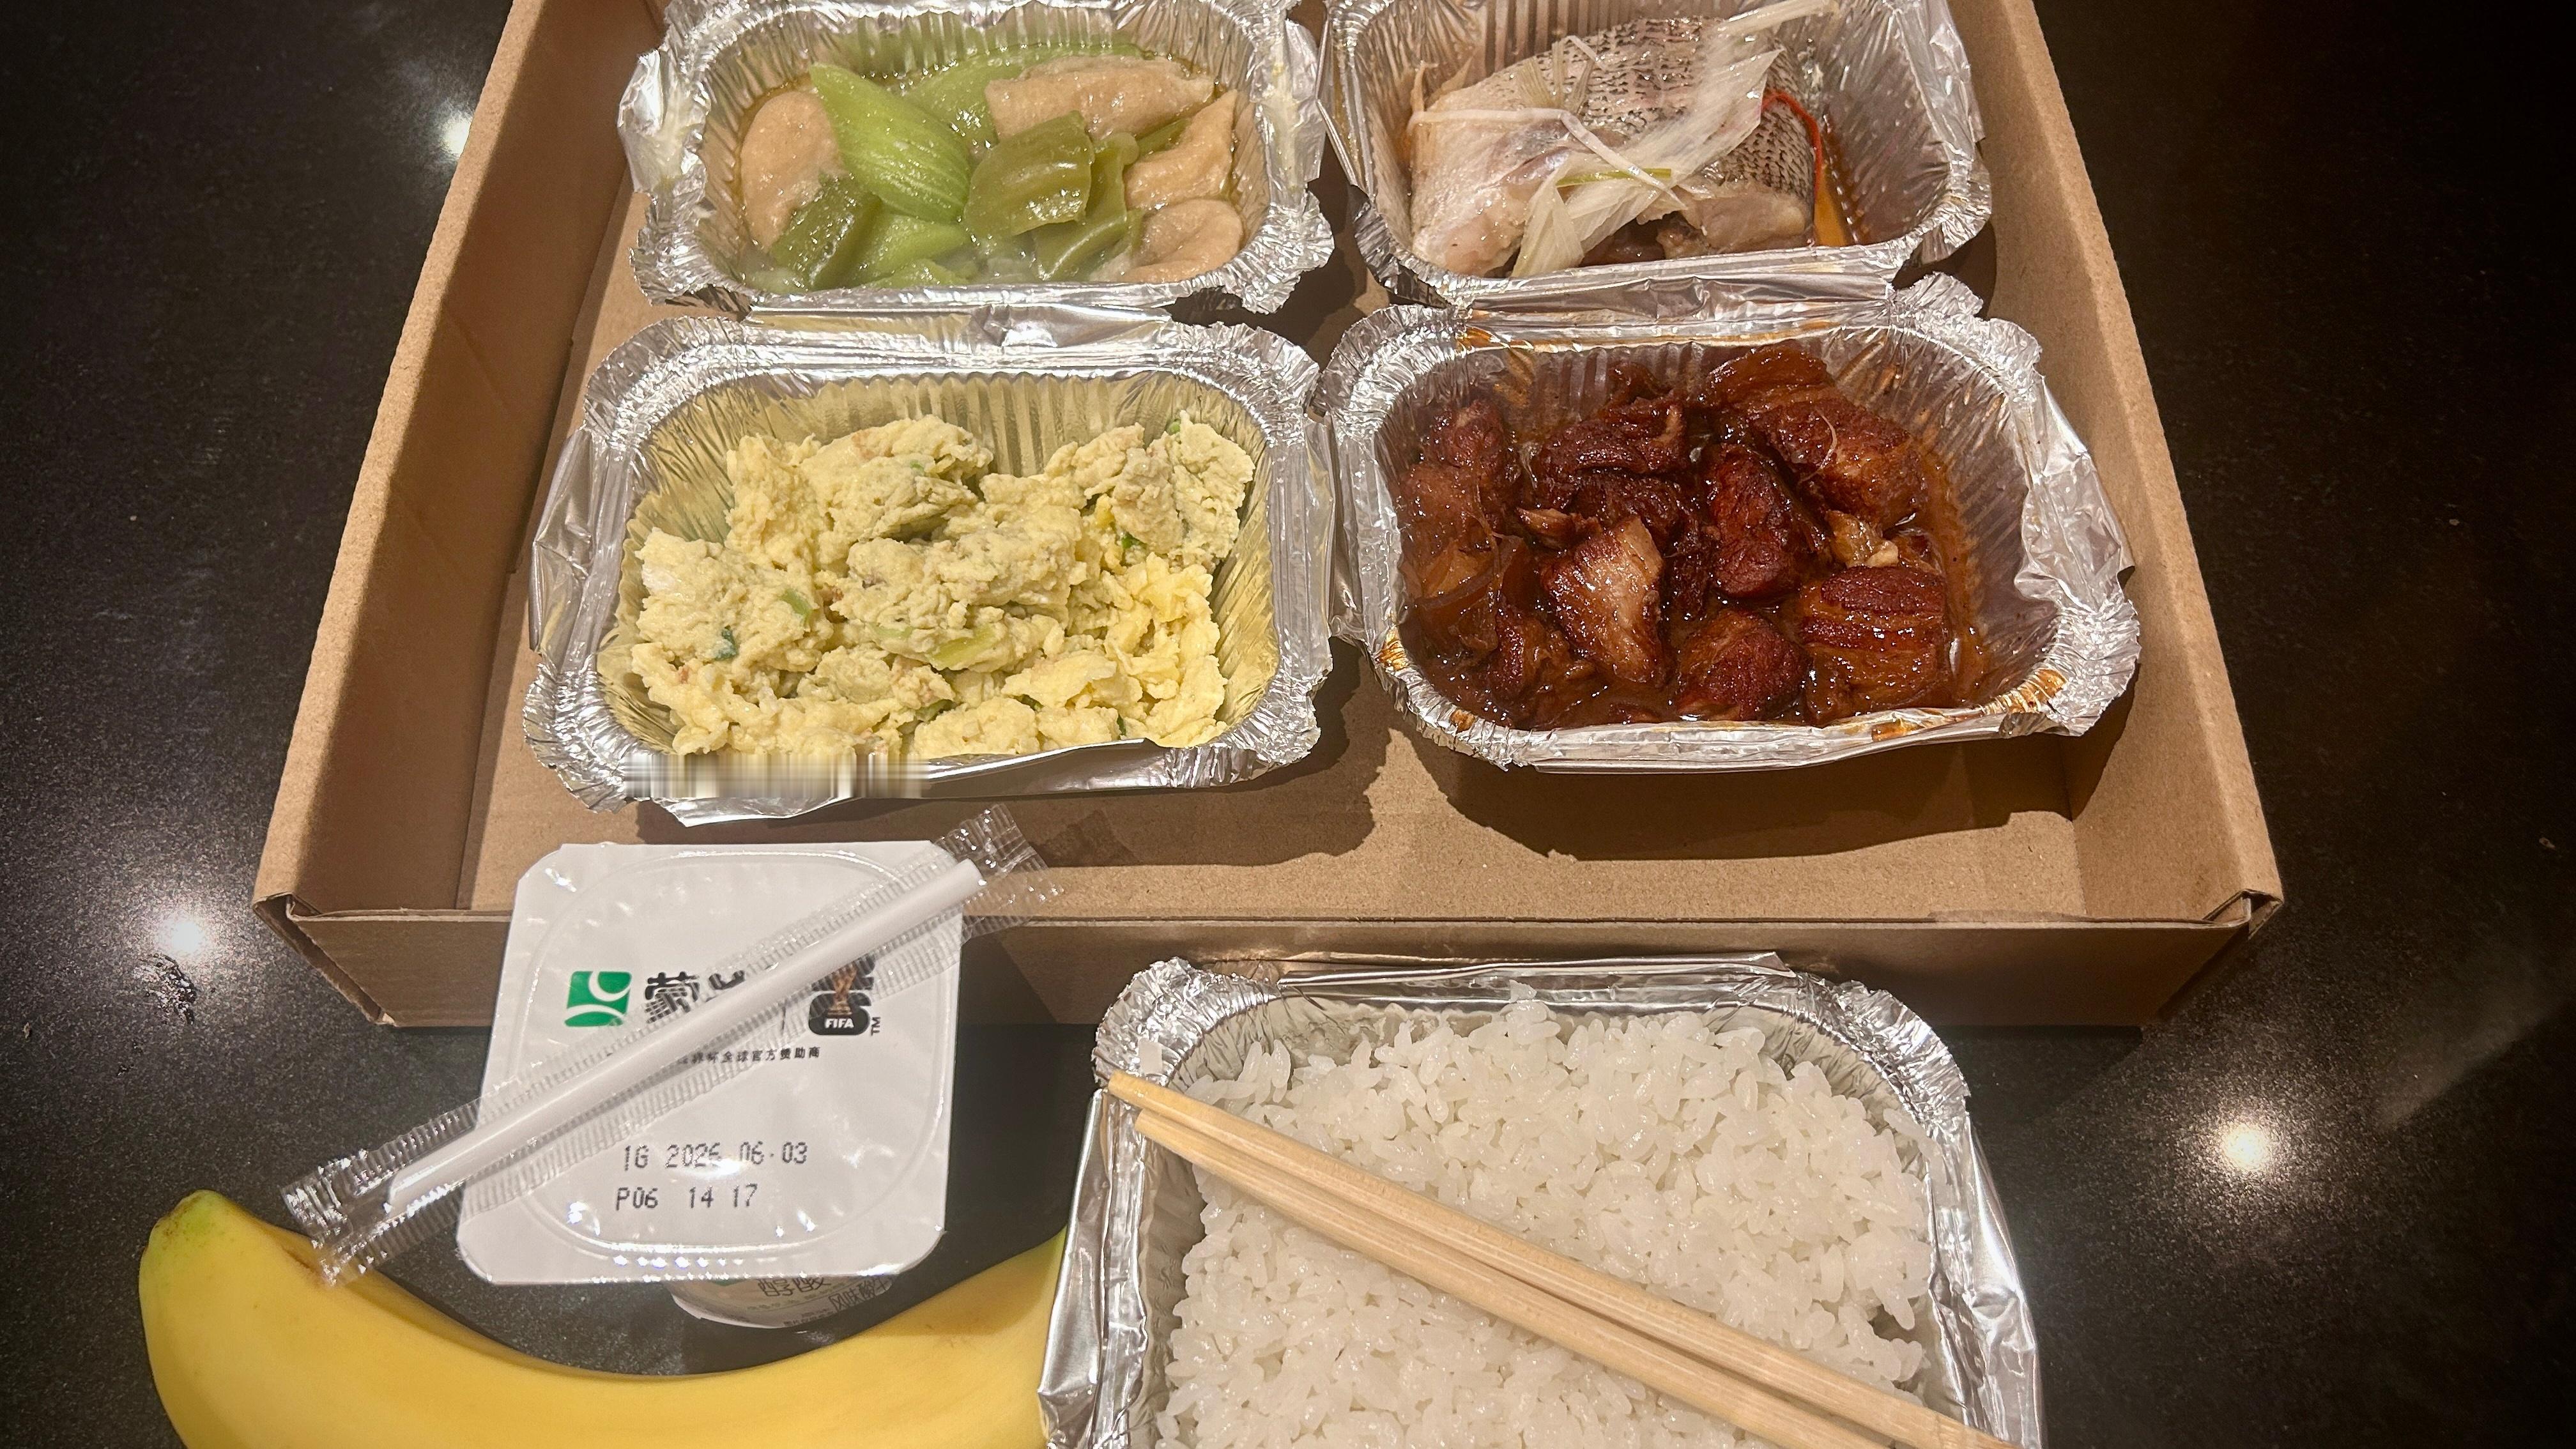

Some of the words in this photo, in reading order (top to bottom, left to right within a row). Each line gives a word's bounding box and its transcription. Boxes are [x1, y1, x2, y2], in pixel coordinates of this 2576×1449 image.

[644, 971, 746, 1023] 蒙
[824, 1018, 855, 1029] FIFA
[870, 1016, 881, 1036] TM
[615, 1186, 659, 1211] P06
[689, 1185, 714, 1209] 14
[733, 1182, 758, 1208] 17
